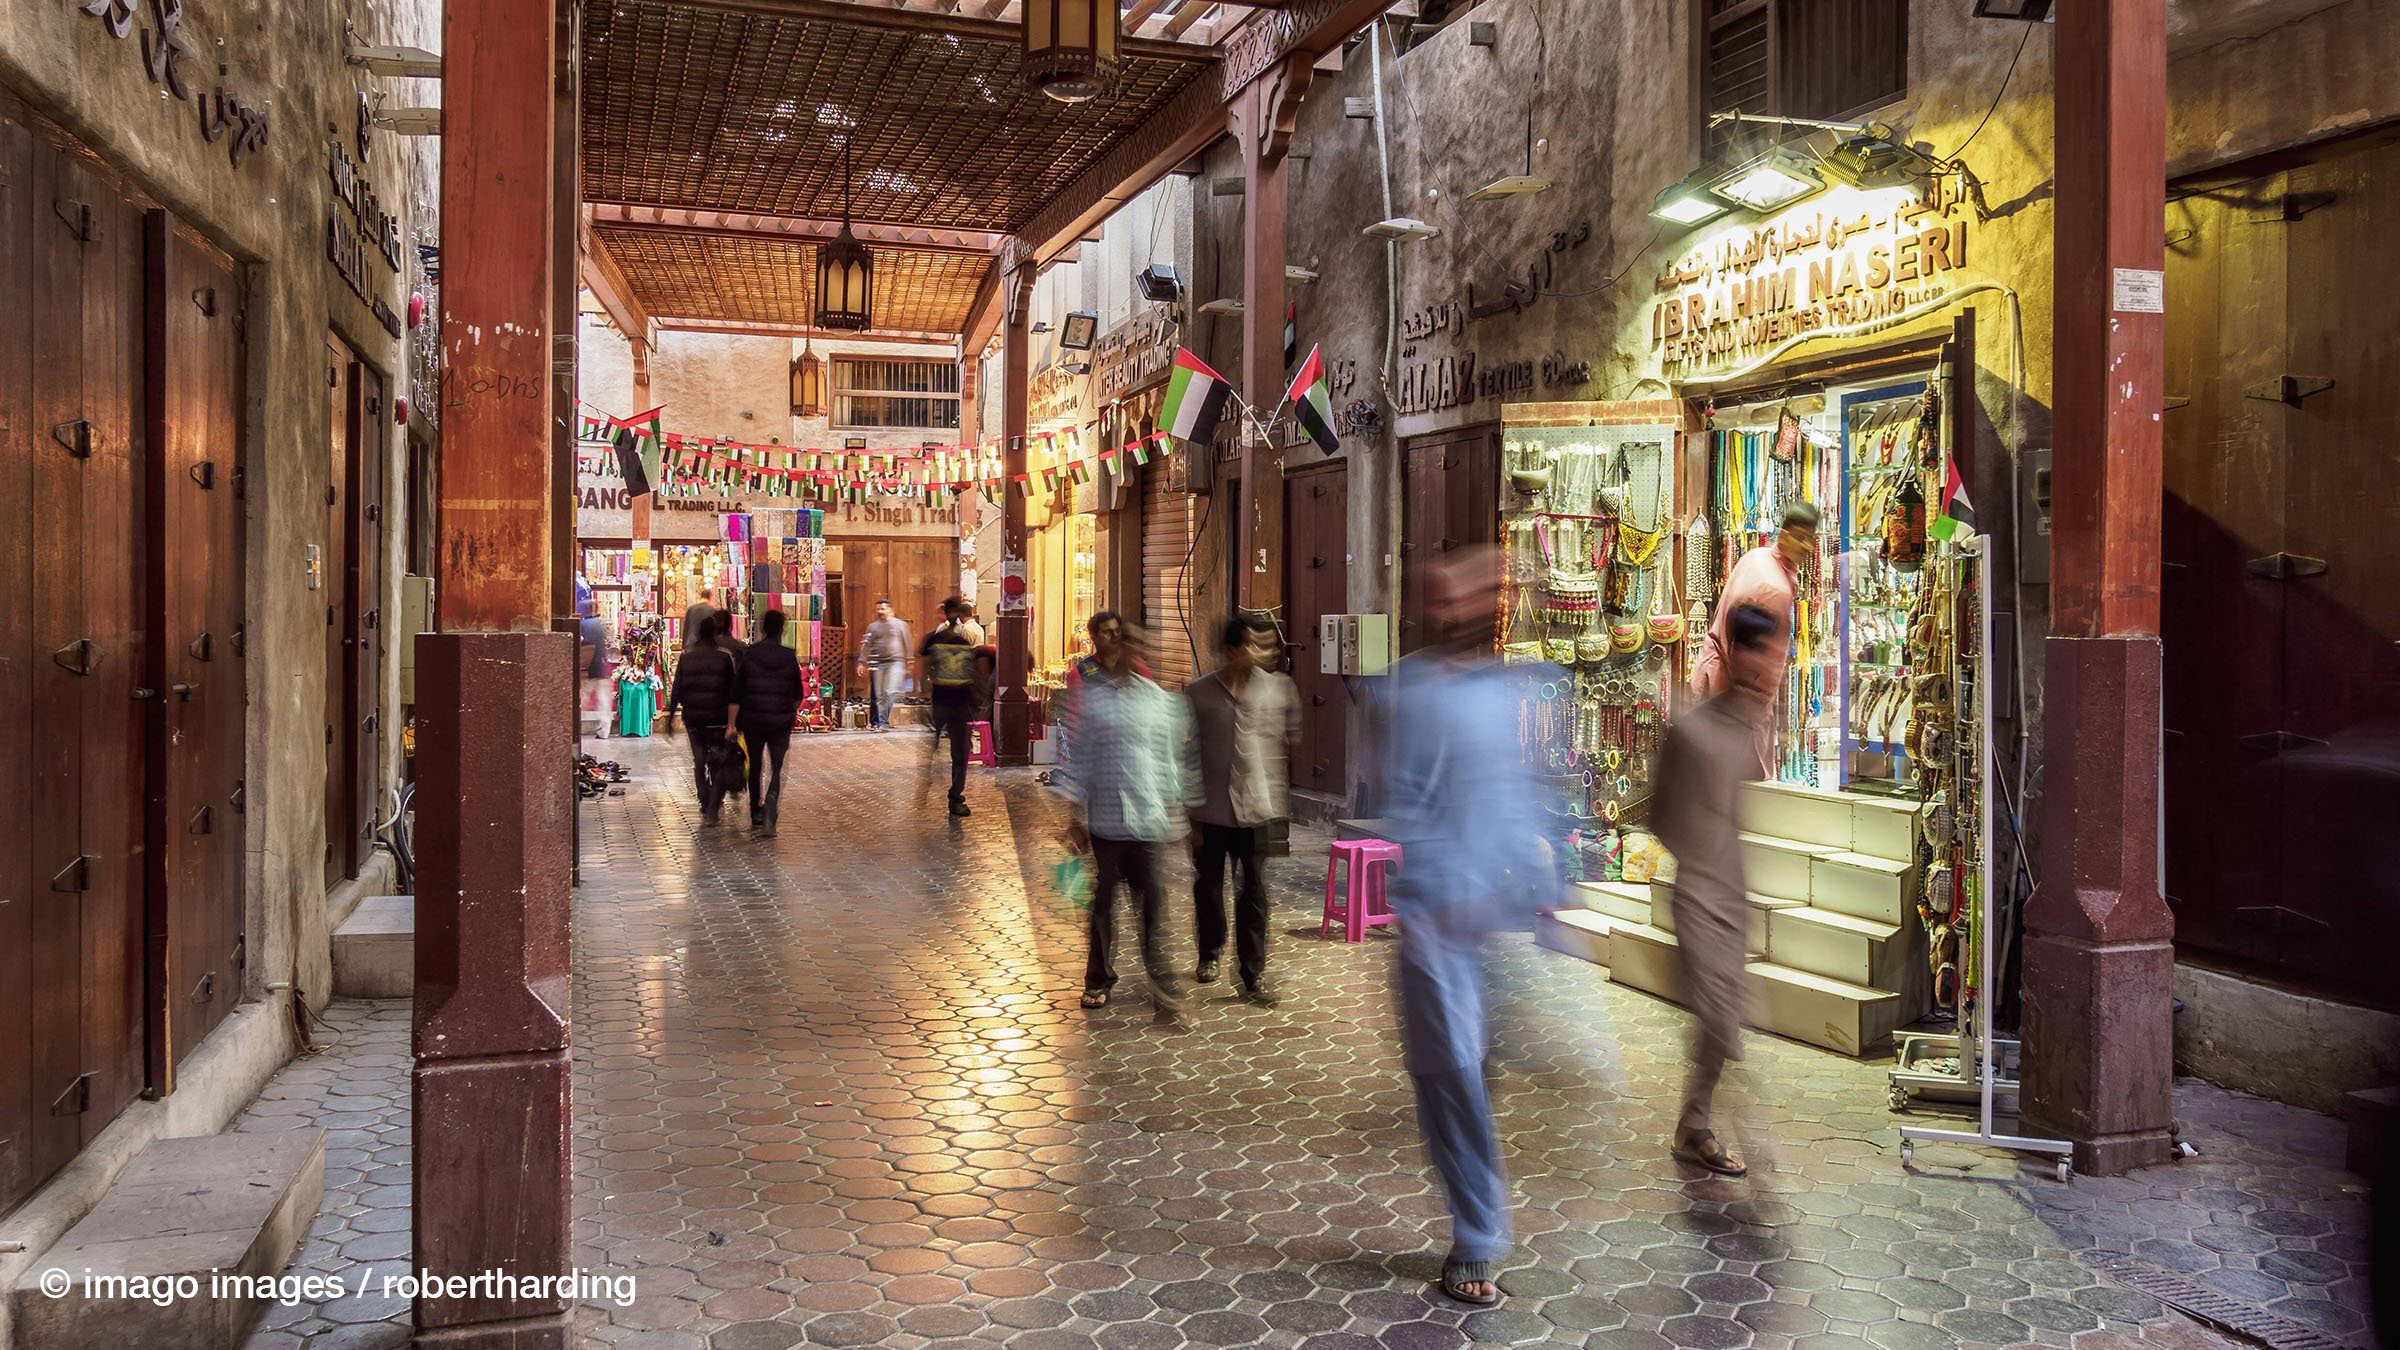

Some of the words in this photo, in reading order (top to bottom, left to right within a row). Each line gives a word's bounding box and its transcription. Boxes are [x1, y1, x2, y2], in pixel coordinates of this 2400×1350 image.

[1653, 267, 1797, 341] IBRAHIM
[1808, 221, 1968, 303] NASERI
[1663, 334, 1704, 363] GIFTS
[1706, 327, 1736, 355] AND
[1739, 306, 1823, 347] NOVELTIES
[1827, 287, 1905, 326] TRADING
[1140, 338, 1172, 379] TRADING
[667, 499, 715, 512] TRADING
[717, 500, 746, 513] L.L.C.
[842, 501, 858, 523] T.
[864, 501, 913, 527] Singh
[916, 502, 983, 529] Tradig
